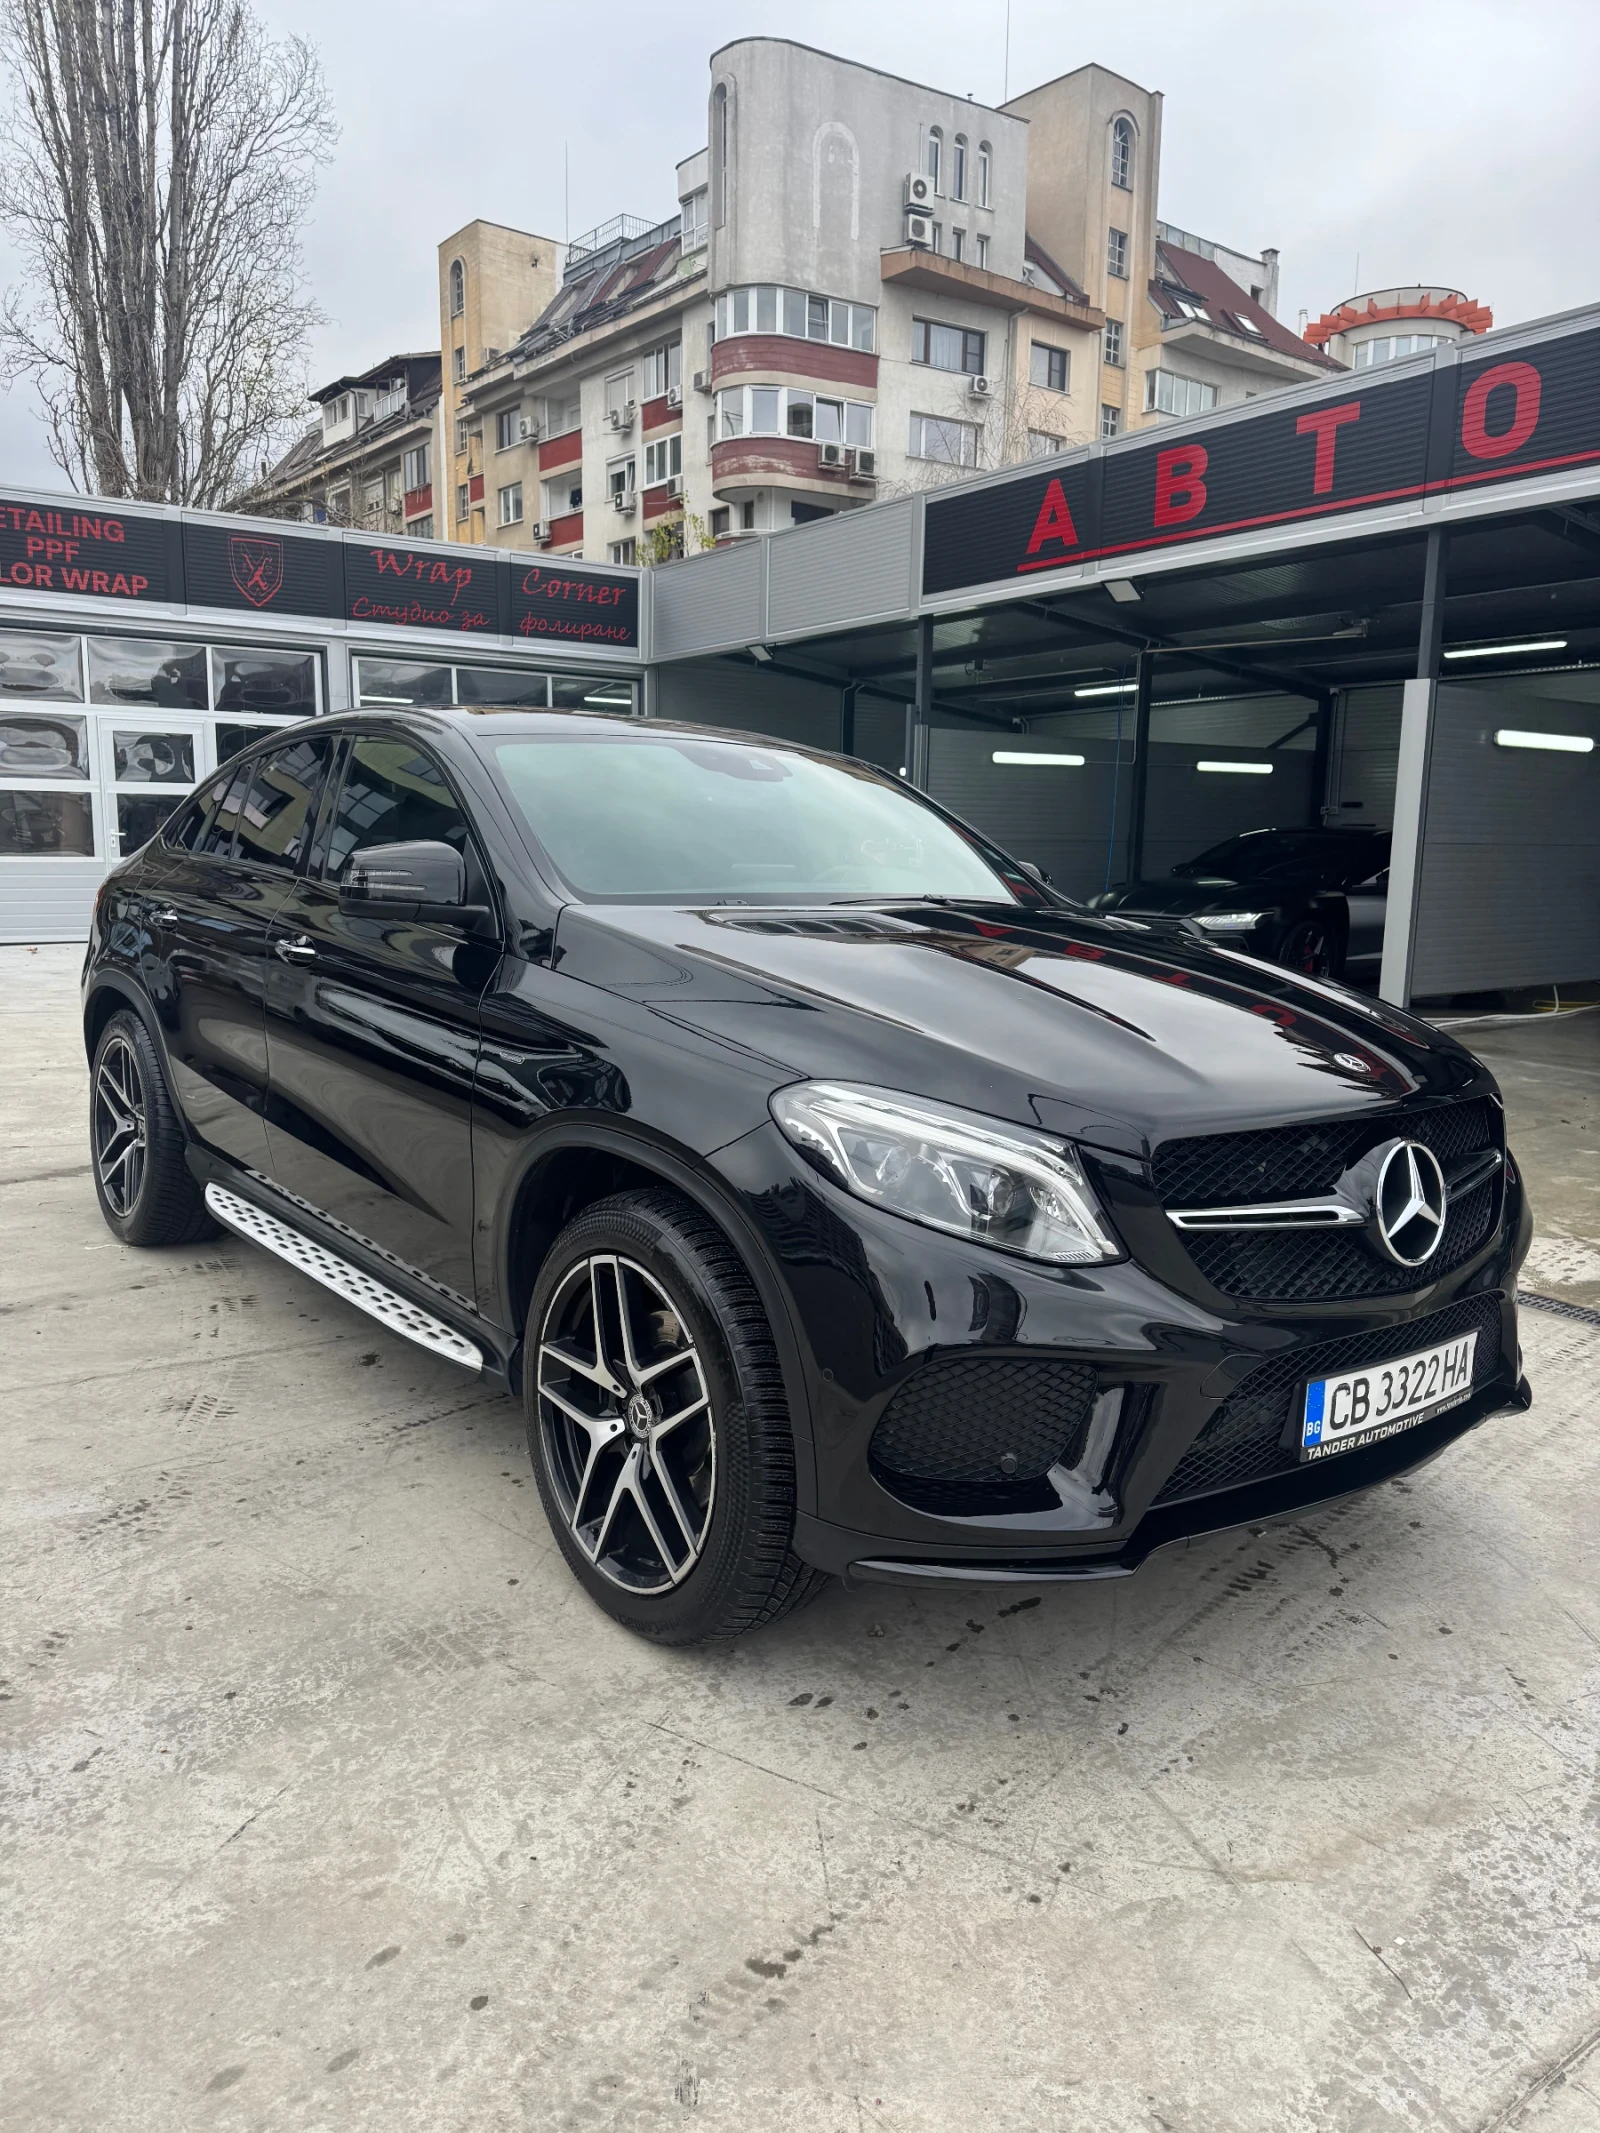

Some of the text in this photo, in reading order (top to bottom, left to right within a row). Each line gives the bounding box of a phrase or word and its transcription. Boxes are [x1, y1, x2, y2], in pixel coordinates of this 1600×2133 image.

[26, 536, 80, 563] PPF
[60, 566, 149, 596] WRAP
[370, 549, 627, 606] Wrap Corner
[351, 596, 632, 641] Студио за фолиране
[1306, 1420, 1321, 1437] BG
[1307, 1412, 1425, 1460] TANDER AUTOMOTIVE
